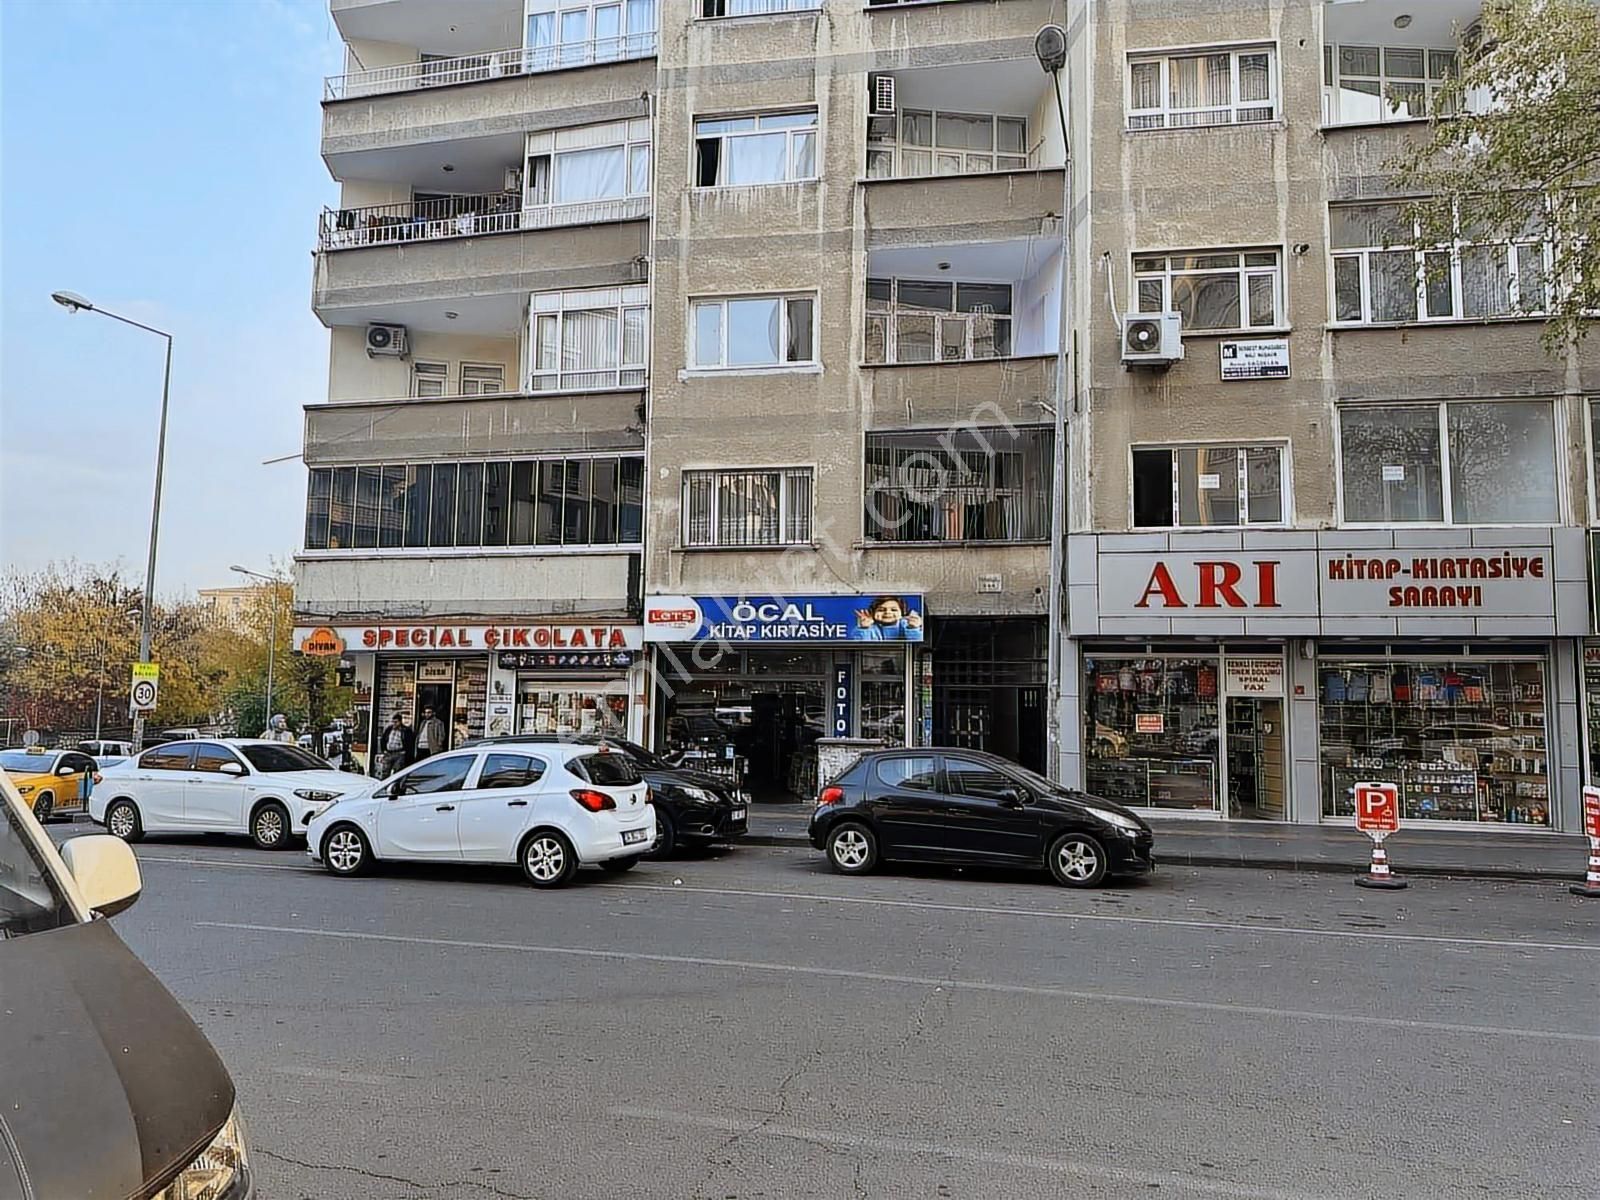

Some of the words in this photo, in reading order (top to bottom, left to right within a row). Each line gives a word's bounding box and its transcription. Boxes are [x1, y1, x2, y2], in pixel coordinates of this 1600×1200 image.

[1328, 551, 1544, 580] KİTAP-KIRTASİYE
[1134, 560, 1281, 608] ARI
[1389, 586, 1482, 607] SARAYI
[732, 600, 825, 622] ÖCAL
[362, 628, 472, 647] SPECIAL
[709, 622, 756, 638] KİTAP
[761, 622, 847, 638] KIRTASİYE
[138, 687, 151, 699] 30
[836, 671, 846, 738] FOTO
[1366, 791, 1387, 814] P
